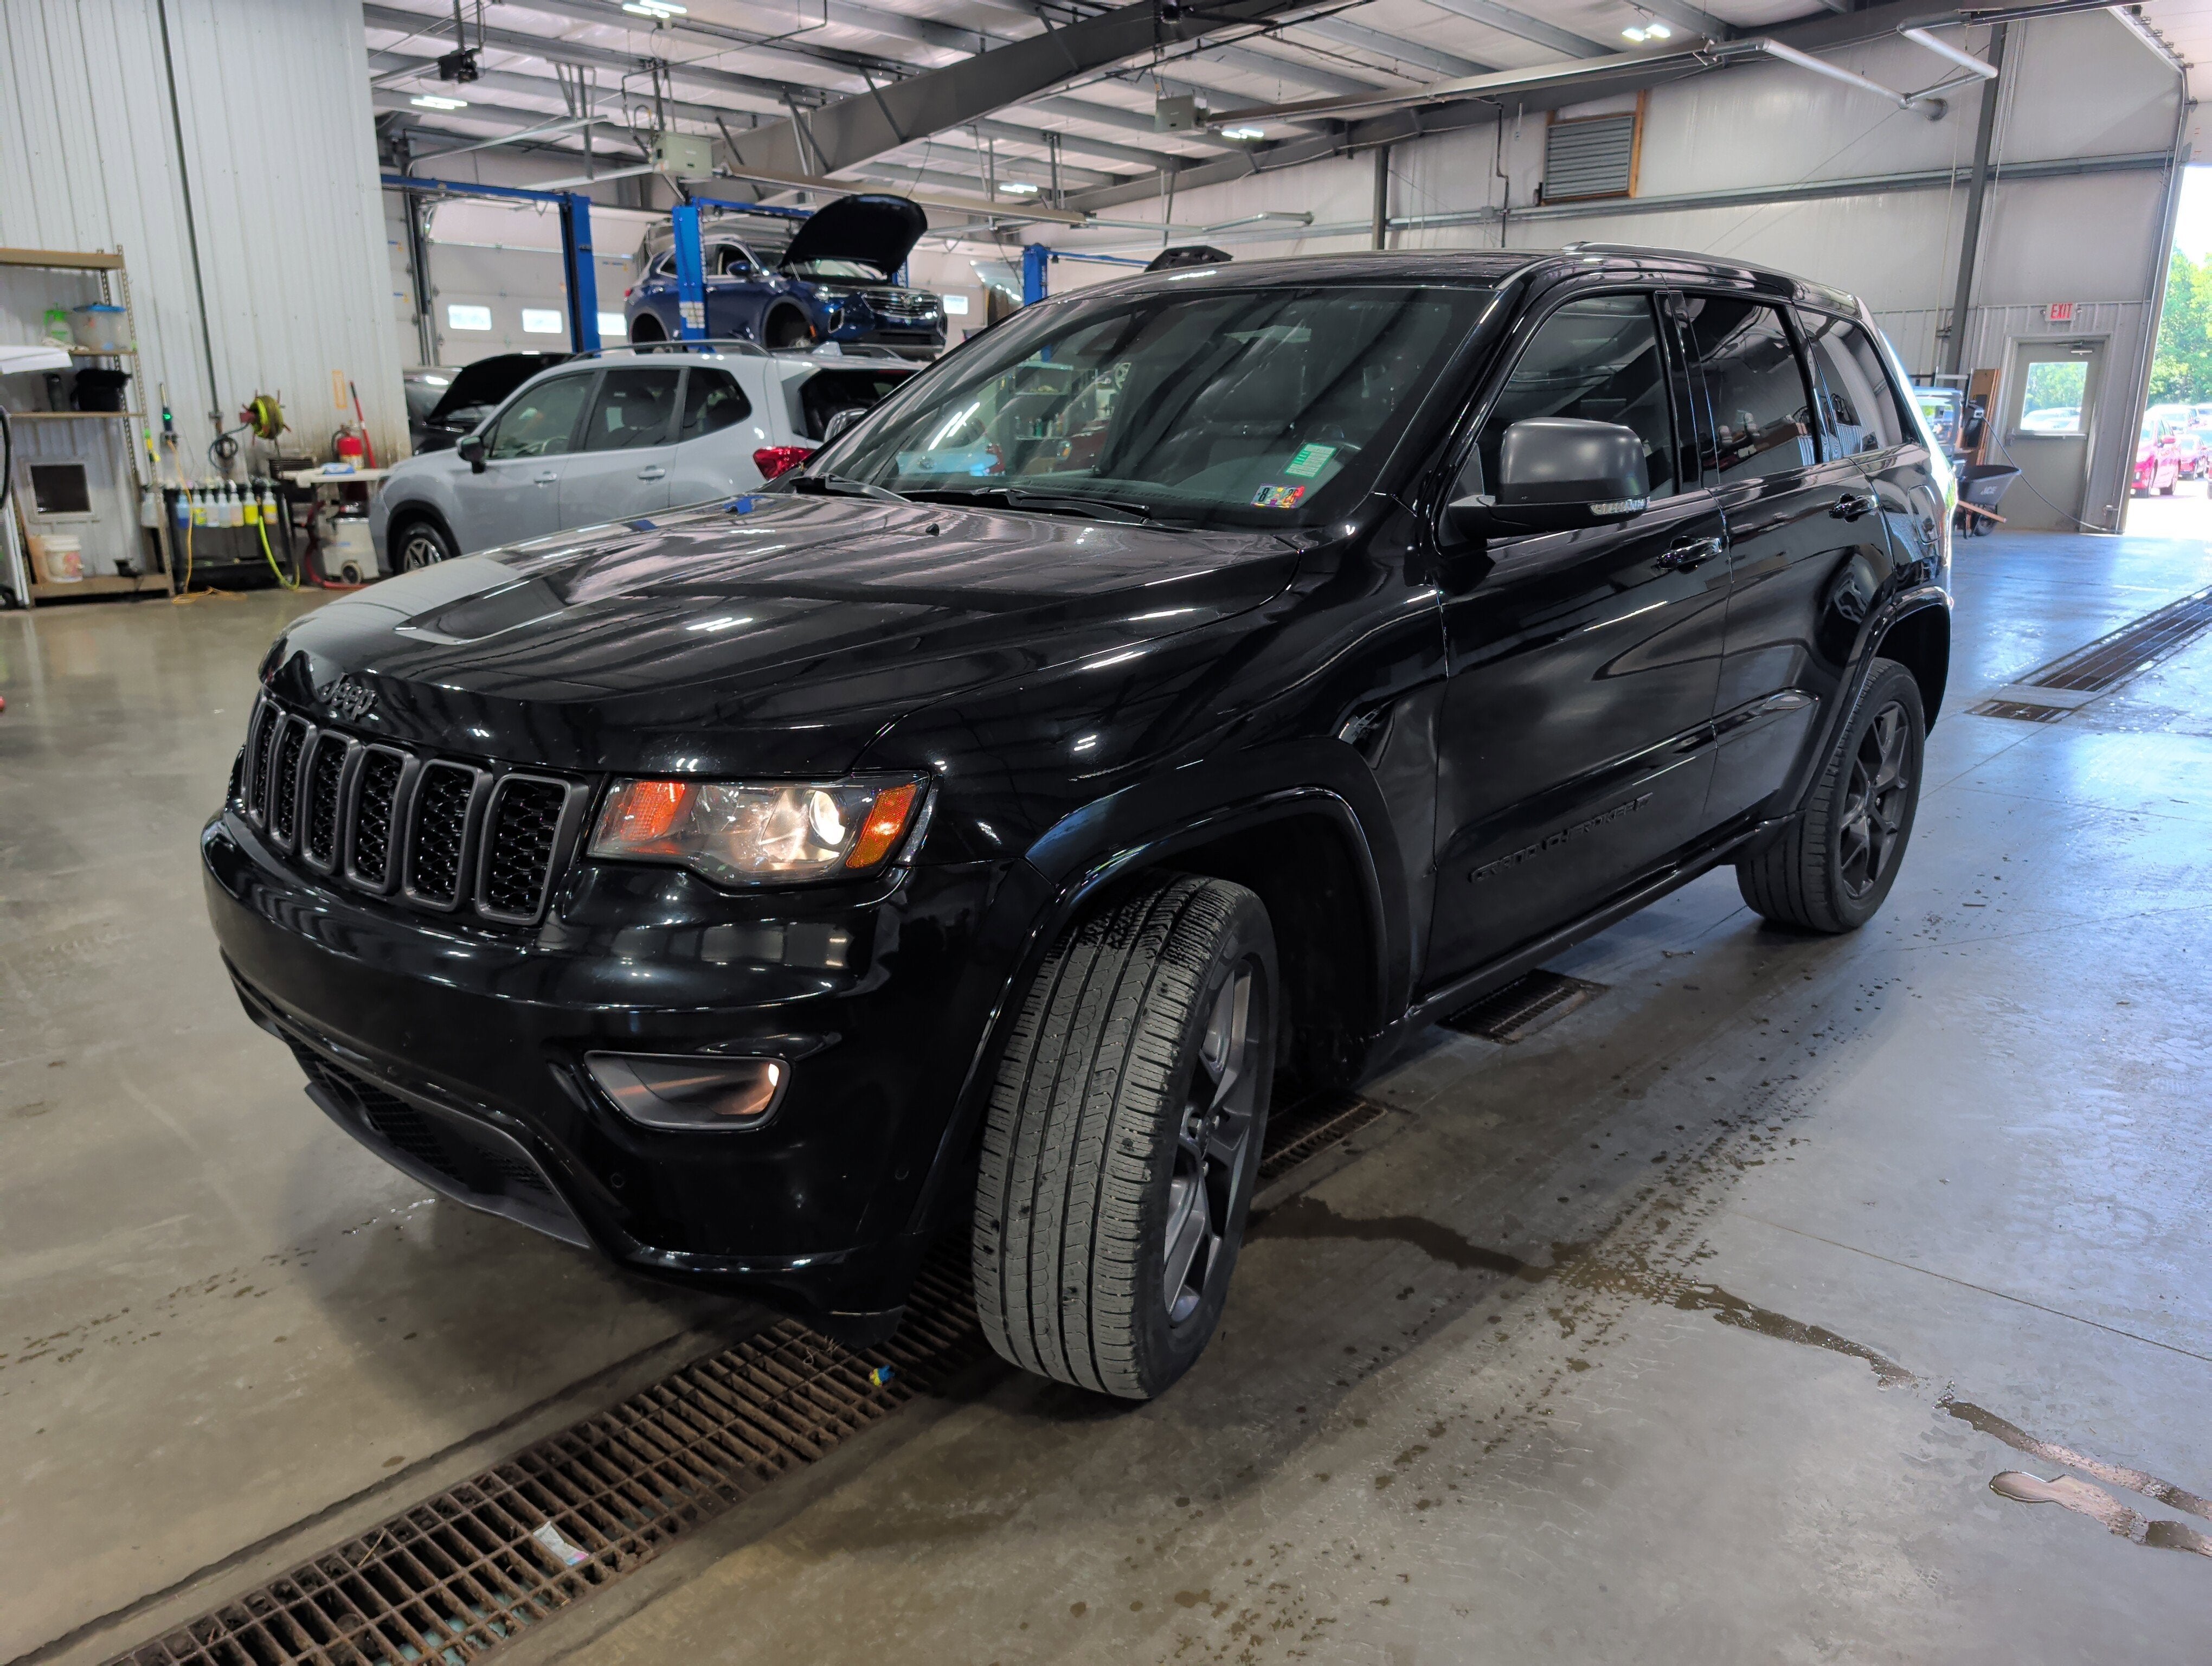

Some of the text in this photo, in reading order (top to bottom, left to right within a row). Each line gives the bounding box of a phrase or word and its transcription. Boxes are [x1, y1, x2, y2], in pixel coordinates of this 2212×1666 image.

[2050, 303, 2073, 319] EXIT
[317, 672, 376, 721] Jeep
[1470, 791, 1654, 883] GRAND CHEROKEE
